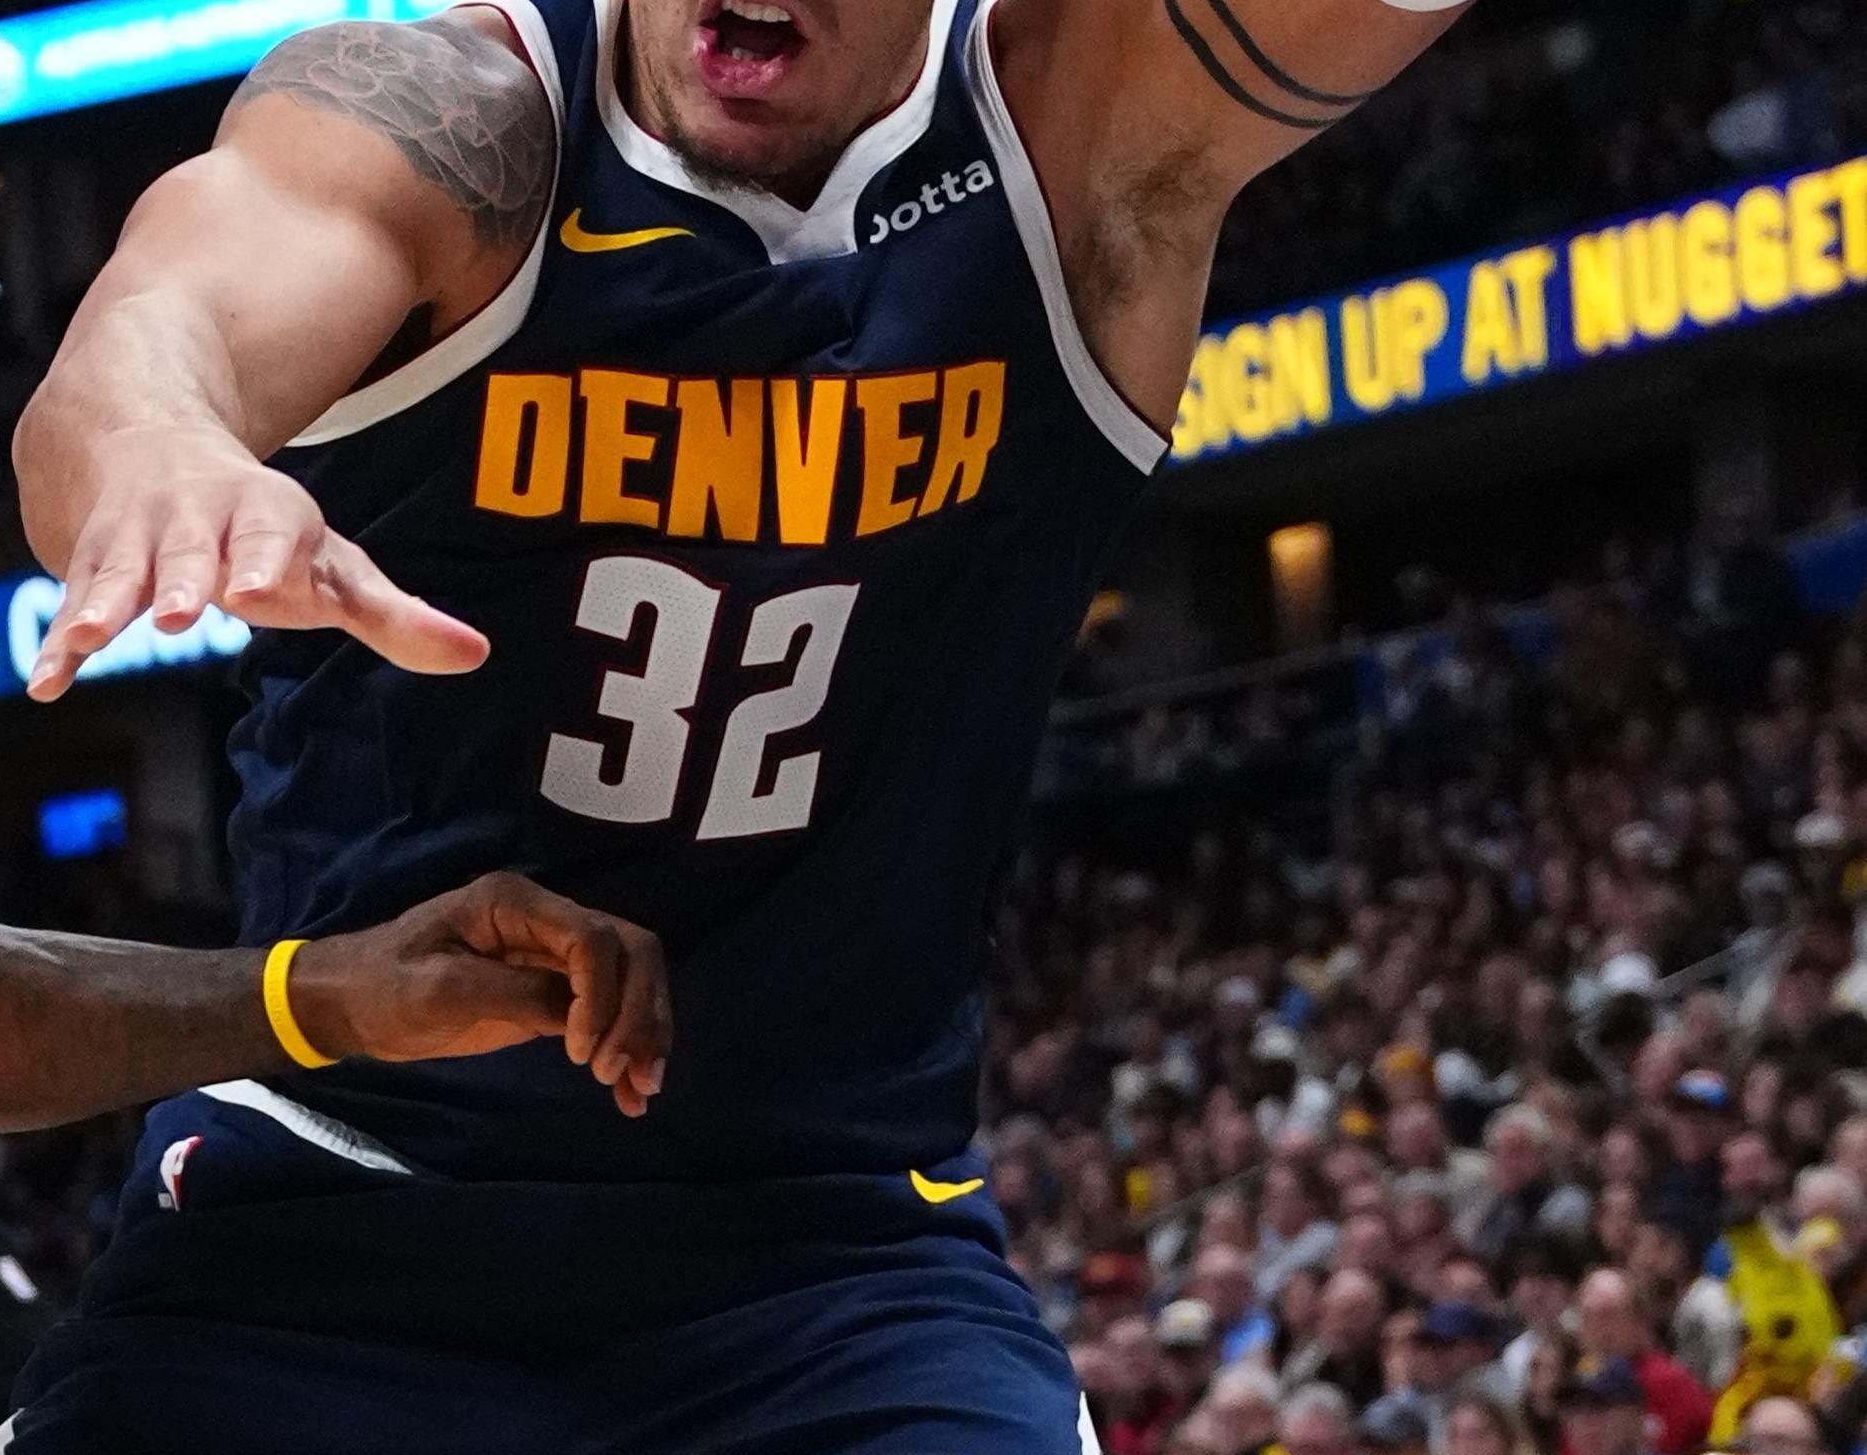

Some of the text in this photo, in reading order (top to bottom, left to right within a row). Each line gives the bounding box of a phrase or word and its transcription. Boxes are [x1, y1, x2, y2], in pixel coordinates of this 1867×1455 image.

[870, 159, 995, 245] otta
[1340, 278, 1449, 413] UP
[1461, 245, 1557, 385] AT
[473, 358, 1006, 545] DENVER
[539, 555, 861, 841] 32
